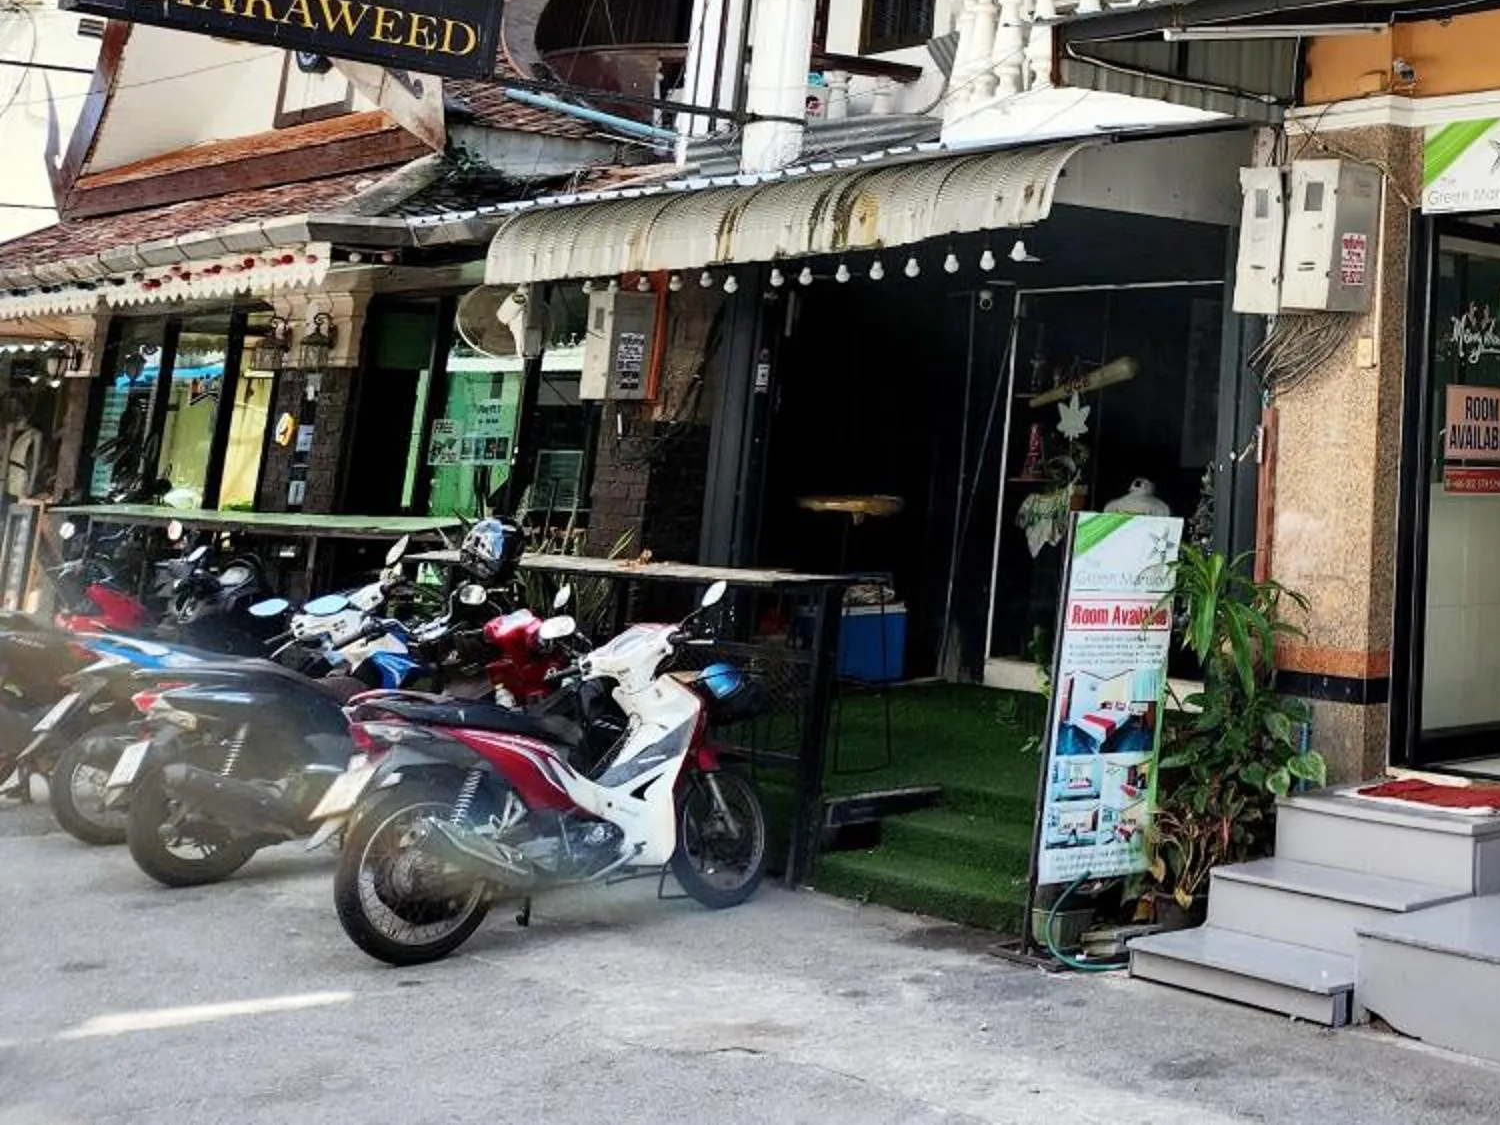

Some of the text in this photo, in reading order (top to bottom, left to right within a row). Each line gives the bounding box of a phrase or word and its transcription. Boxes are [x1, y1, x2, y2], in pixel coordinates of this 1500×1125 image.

[1428, 189, 1470, 206] Green
[1465, 395, 1499, 421] ROOM
[1071, 603, 1110, 625] Room
